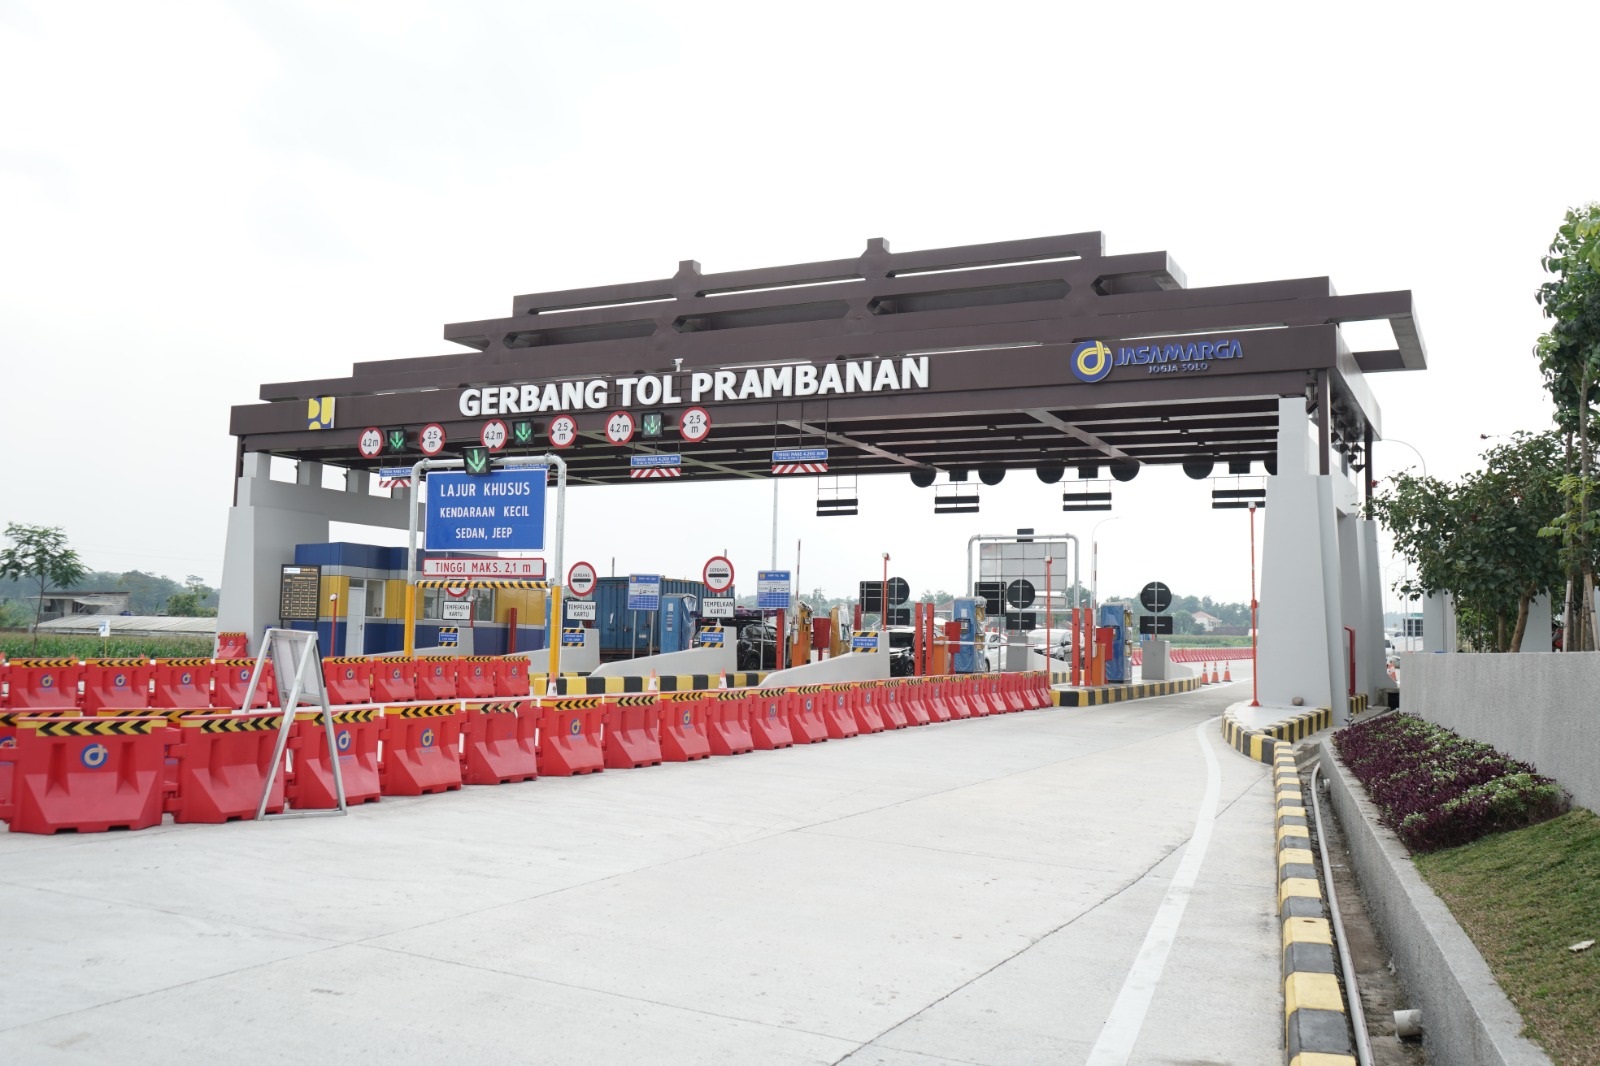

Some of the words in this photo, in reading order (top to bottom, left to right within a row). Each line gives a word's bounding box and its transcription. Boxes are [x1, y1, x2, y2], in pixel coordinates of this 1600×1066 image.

[1115, 338, 1243, 366] JASAMARGA
[1148, 364, 1178, 374] JOGJA
[1181, 362, 1208, 372] SOLO
[458, 379, 608, 417] GERBANG
[616, 375, 681, 407] TOL
[691, 356, 929, 402] PRAMBANAN
[689, 415, 701, 424] 2.5
[557, 422, 568, 431] 2.5
[610, 423, 621, 432] 4.2
[622, 424, 629, 432] m
[427, 431, 438, 440] 2.5
[485, 430, 495, 440] 4.2
[362, 438, 372, 447] 4.2
[440, 483, 476, 497] LAJUR
[484, 482, 530, 496] KHUSUS
[440, 506, 495, 518] KENDARAAN
[503, 506, 530, 517] KECIL
[455, 528, 488, 540] SEDAN,
[492, 527, 513, 539] JEEP
[435, 562, 466, 573] TINGGI
[522, 564, 531, 573] m
